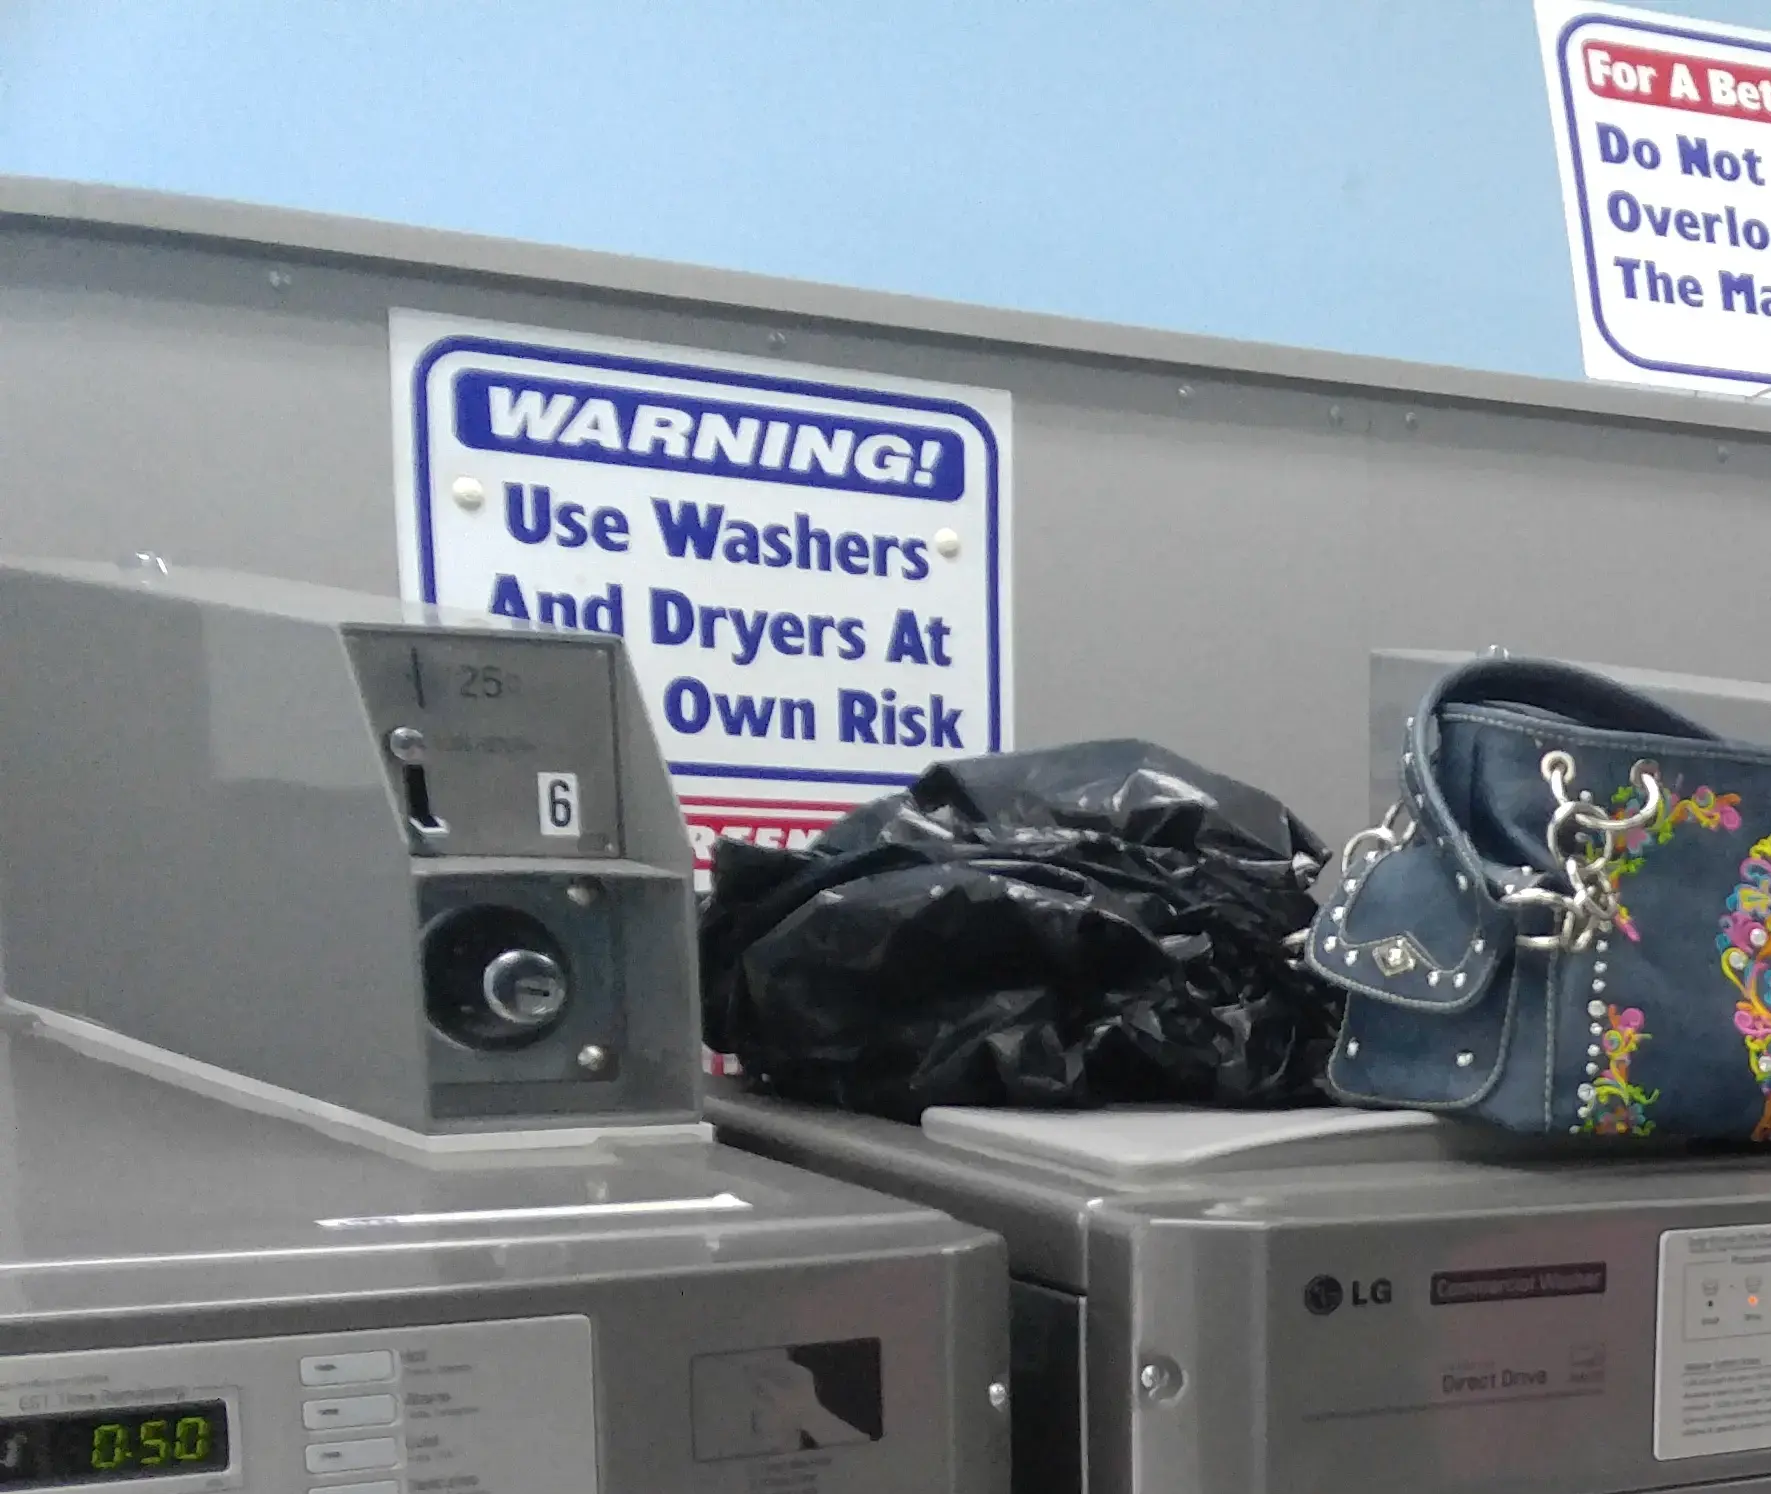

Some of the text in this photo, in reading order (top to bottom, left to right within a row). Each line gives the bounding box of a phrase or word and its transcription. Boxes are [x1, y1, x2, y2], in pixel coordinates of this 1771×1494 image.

[1587, 49, 1656, 94] For
[1670, 63, 1701, 101] A
[1596, 122, 1765, 186] Do Not
[1613, 256, 1704, 308] The
[487, 386, 943, 487] WARNING!
[503, 481, 929, 580] Use Washers
[489, 574, 952, 667] And Dryers At
[664, 676, 964, 749] Own Risk
[549, 779, 571, 827] 6
[1351, 1278, 1393, 1306] LG
[1442, 1369, 1548, 1394] Direct Drive
